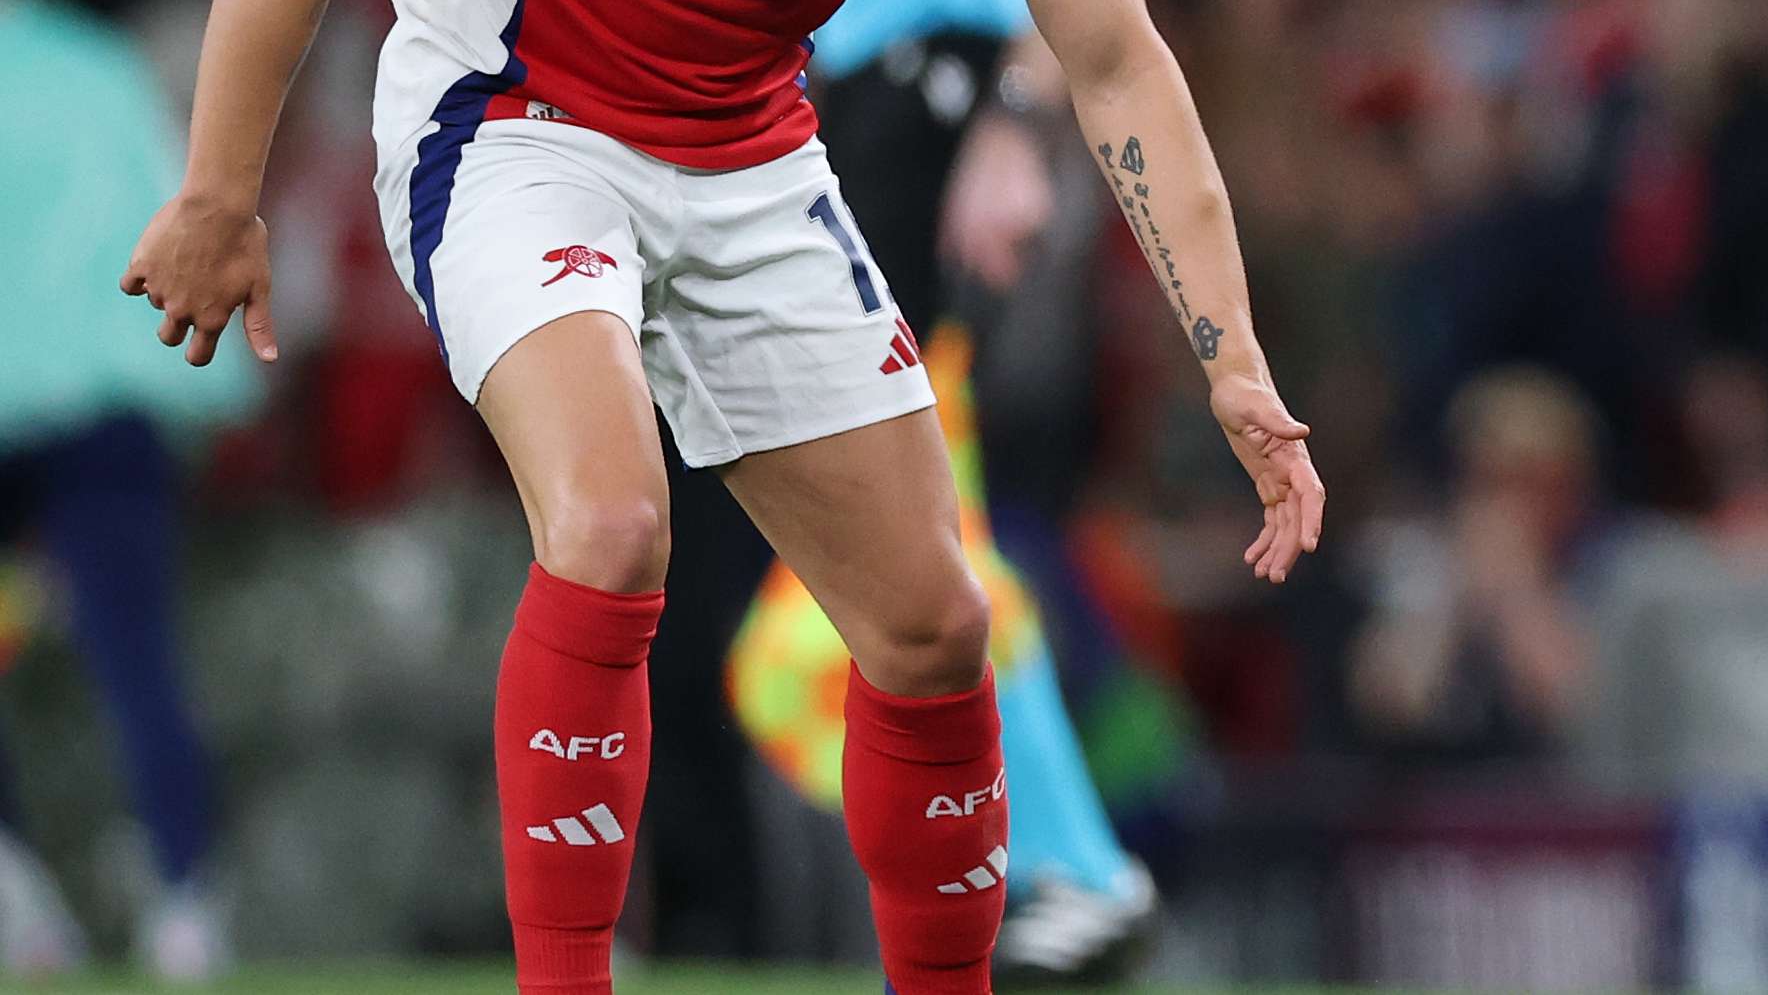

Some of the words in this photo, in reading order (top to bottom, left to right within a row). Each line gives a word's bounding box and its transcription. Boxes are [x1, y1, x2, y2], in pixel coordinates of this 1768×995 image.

[804, 190, 895, 317] 1
[529, 729, 625, 761] AFC
[926, 766, 1006, 819] AFC
